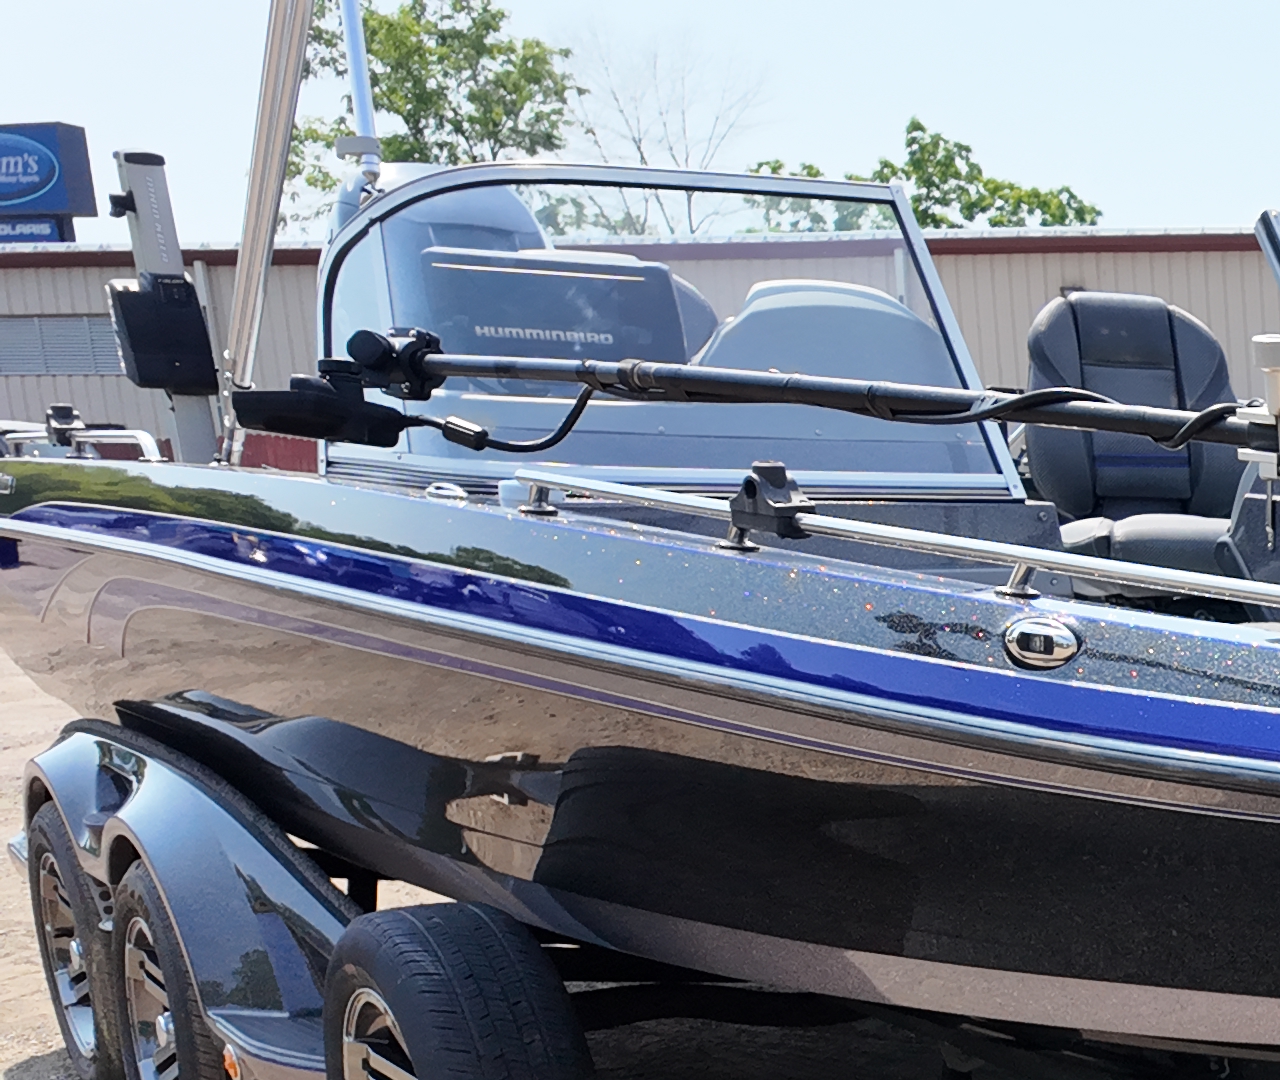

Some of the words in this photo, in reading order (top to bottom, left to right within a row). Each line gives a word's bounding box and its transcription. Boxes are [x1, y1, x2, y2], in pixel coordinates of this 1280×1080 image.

[0, 153, 39, 174] m's
[0, 223, 52, 235] OLARIS
[475, 325, 614, 345] HUMMINBIRD
